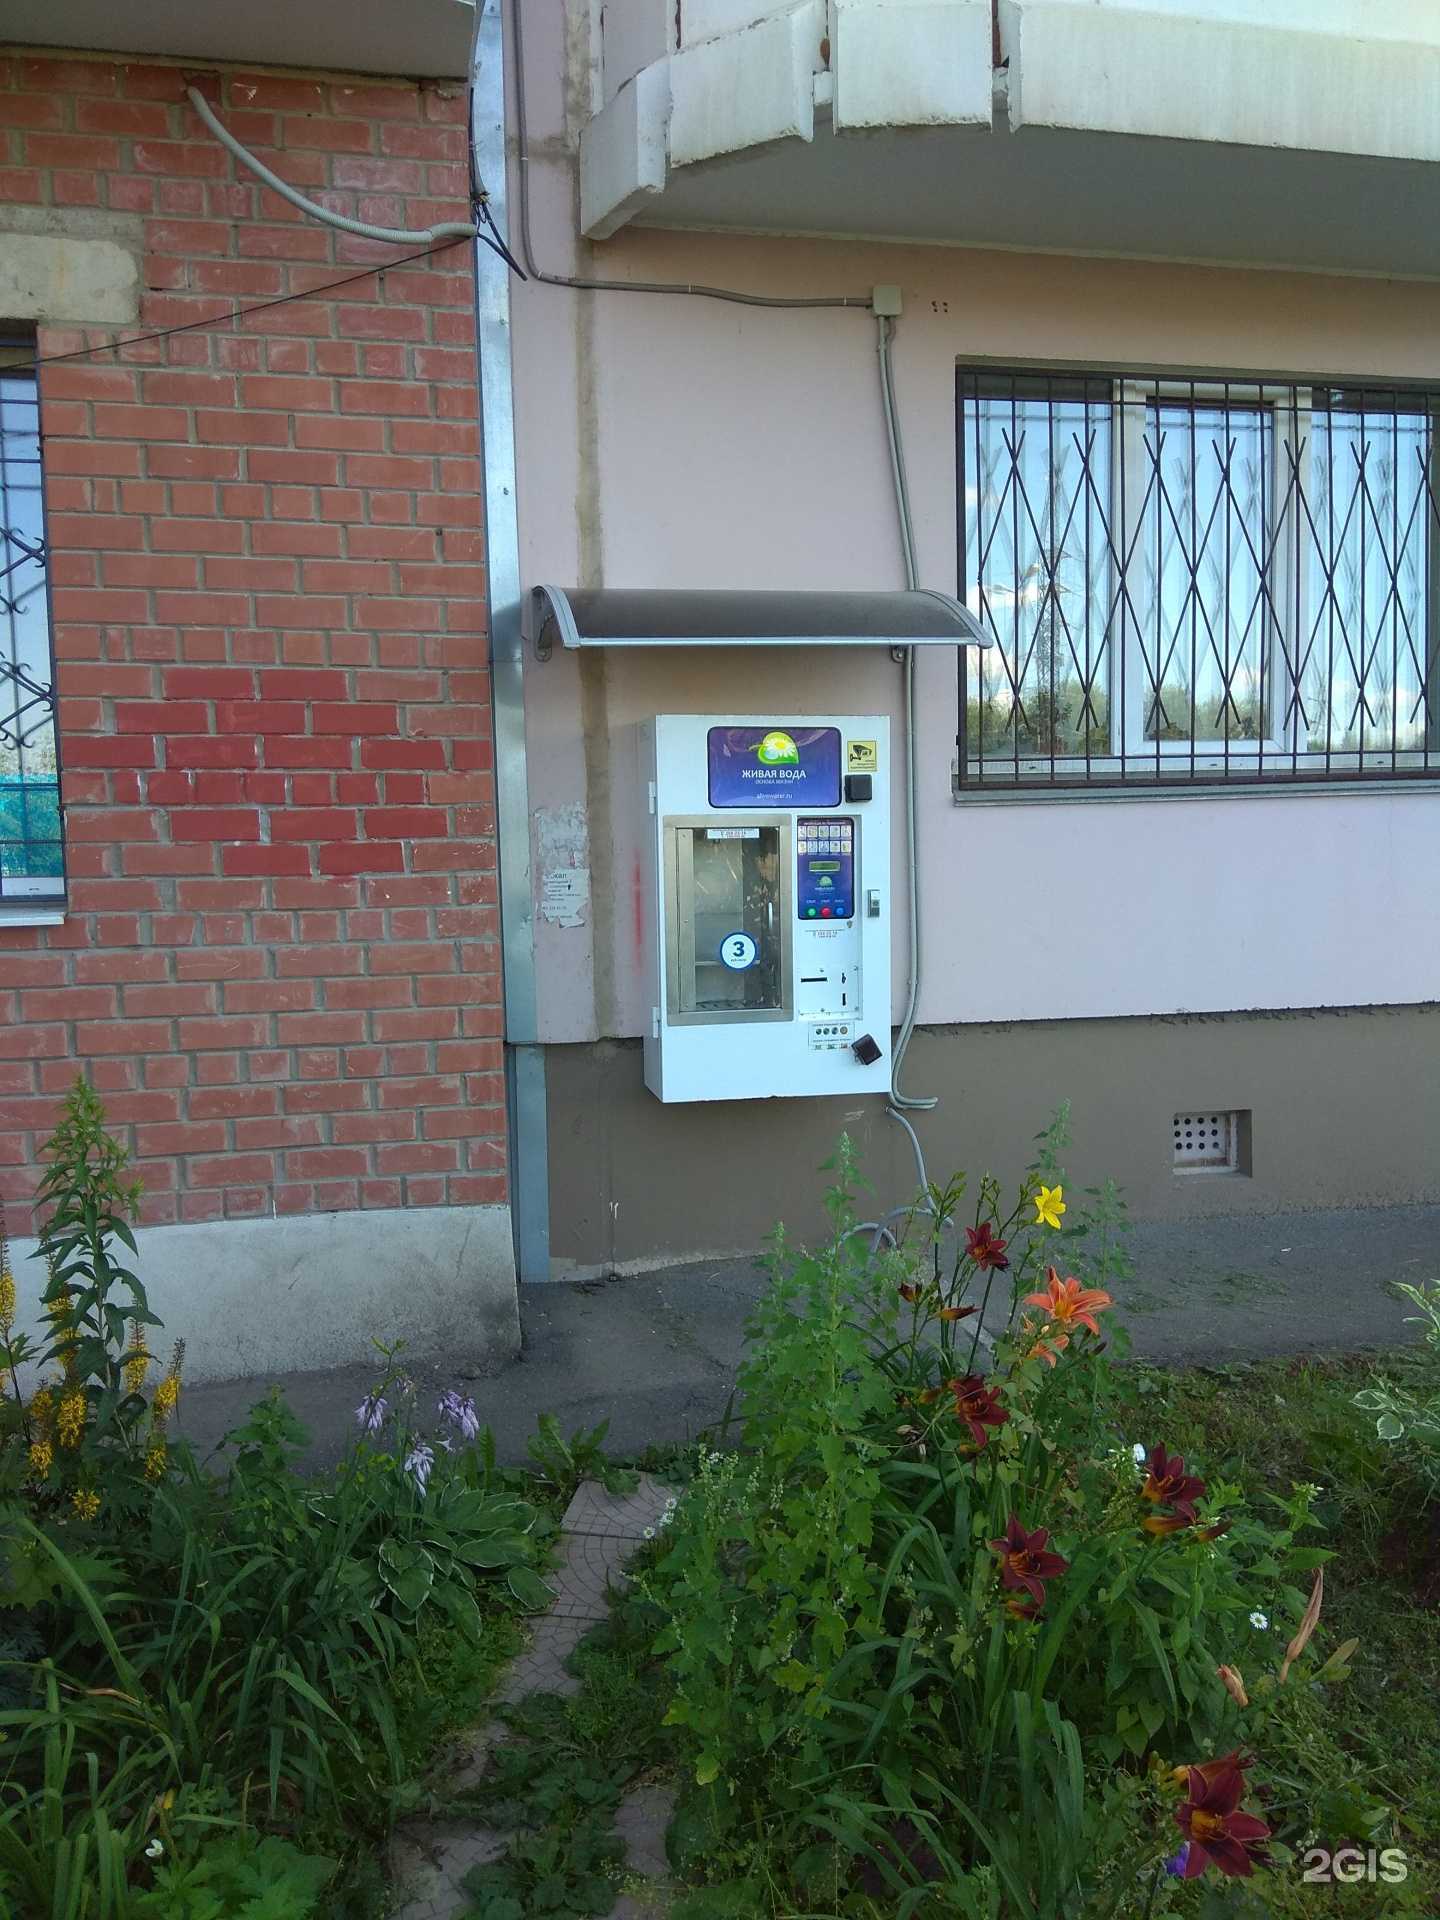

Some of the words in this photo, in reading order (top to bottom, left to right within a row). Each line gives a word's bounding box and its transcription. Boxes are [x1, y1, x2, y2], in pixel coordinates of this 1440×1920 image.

[742, 769, 777, 779] ЖИВАЯ
[779, 769, 806, 780] ВОДА
[732, 941, 745, 957] 3
